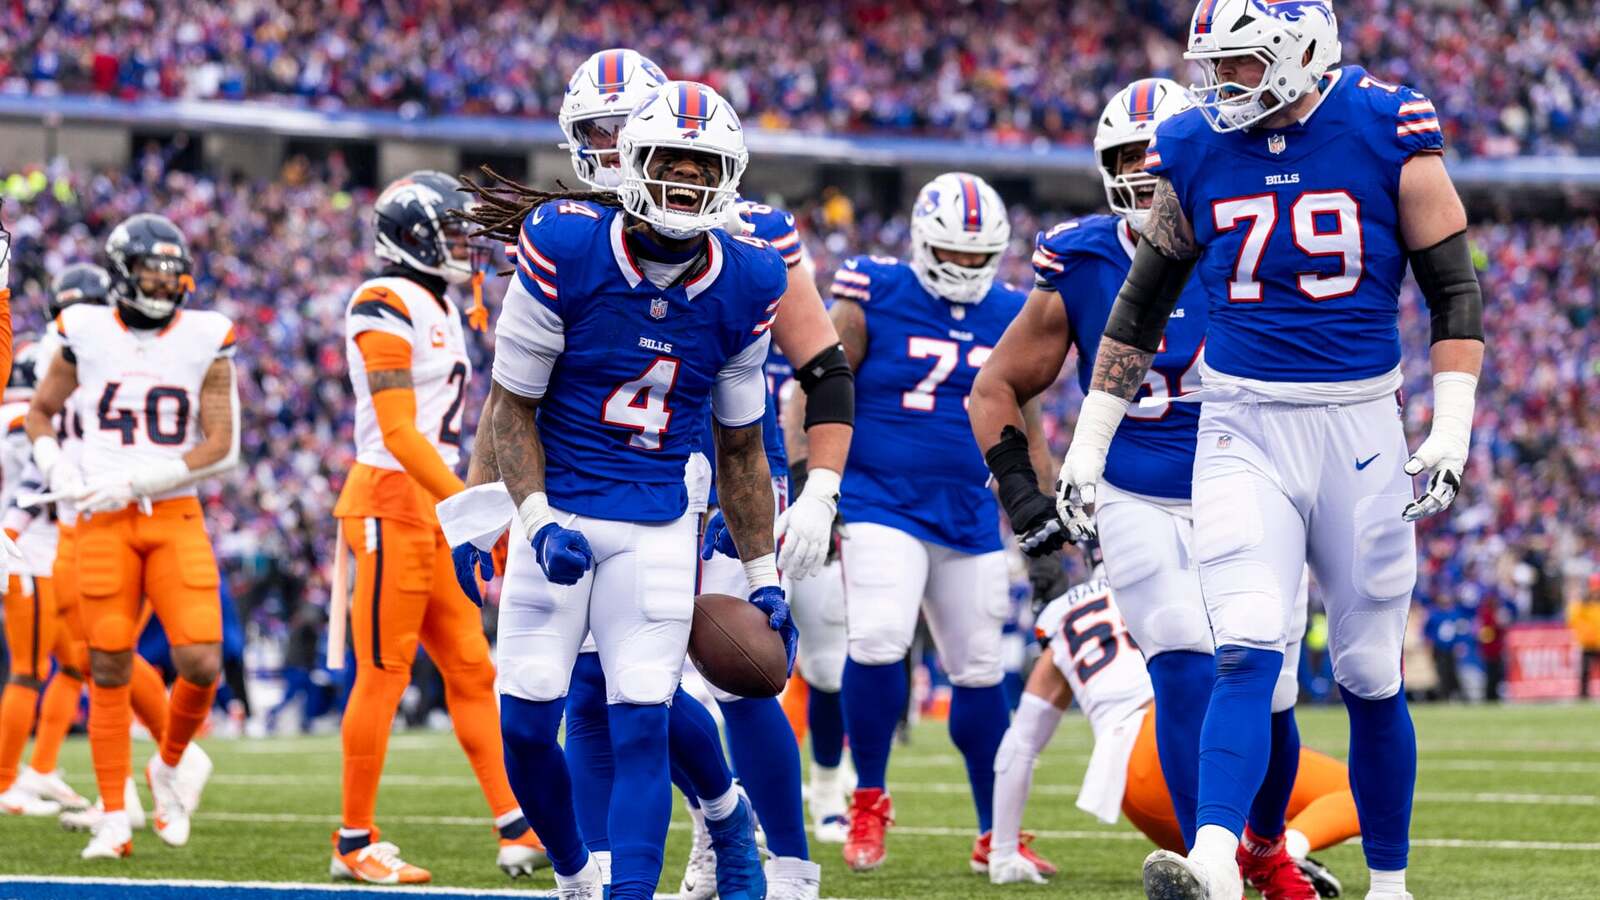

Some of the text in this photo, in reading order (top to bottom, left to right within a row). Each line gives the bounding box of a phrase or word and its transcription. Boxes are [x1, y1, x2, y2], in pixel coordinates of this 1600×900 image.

[1265, 173, 1300, 185] BILLS
[1211, 189, 1365, 303] 79
[638, 336, 673, 353] BILLS
[98, 380, 191, 446] 40
[438, 360, 467, 448] 2
[602, 356, 681, 451] 4
[1061, 594, 1140, 687] 5
